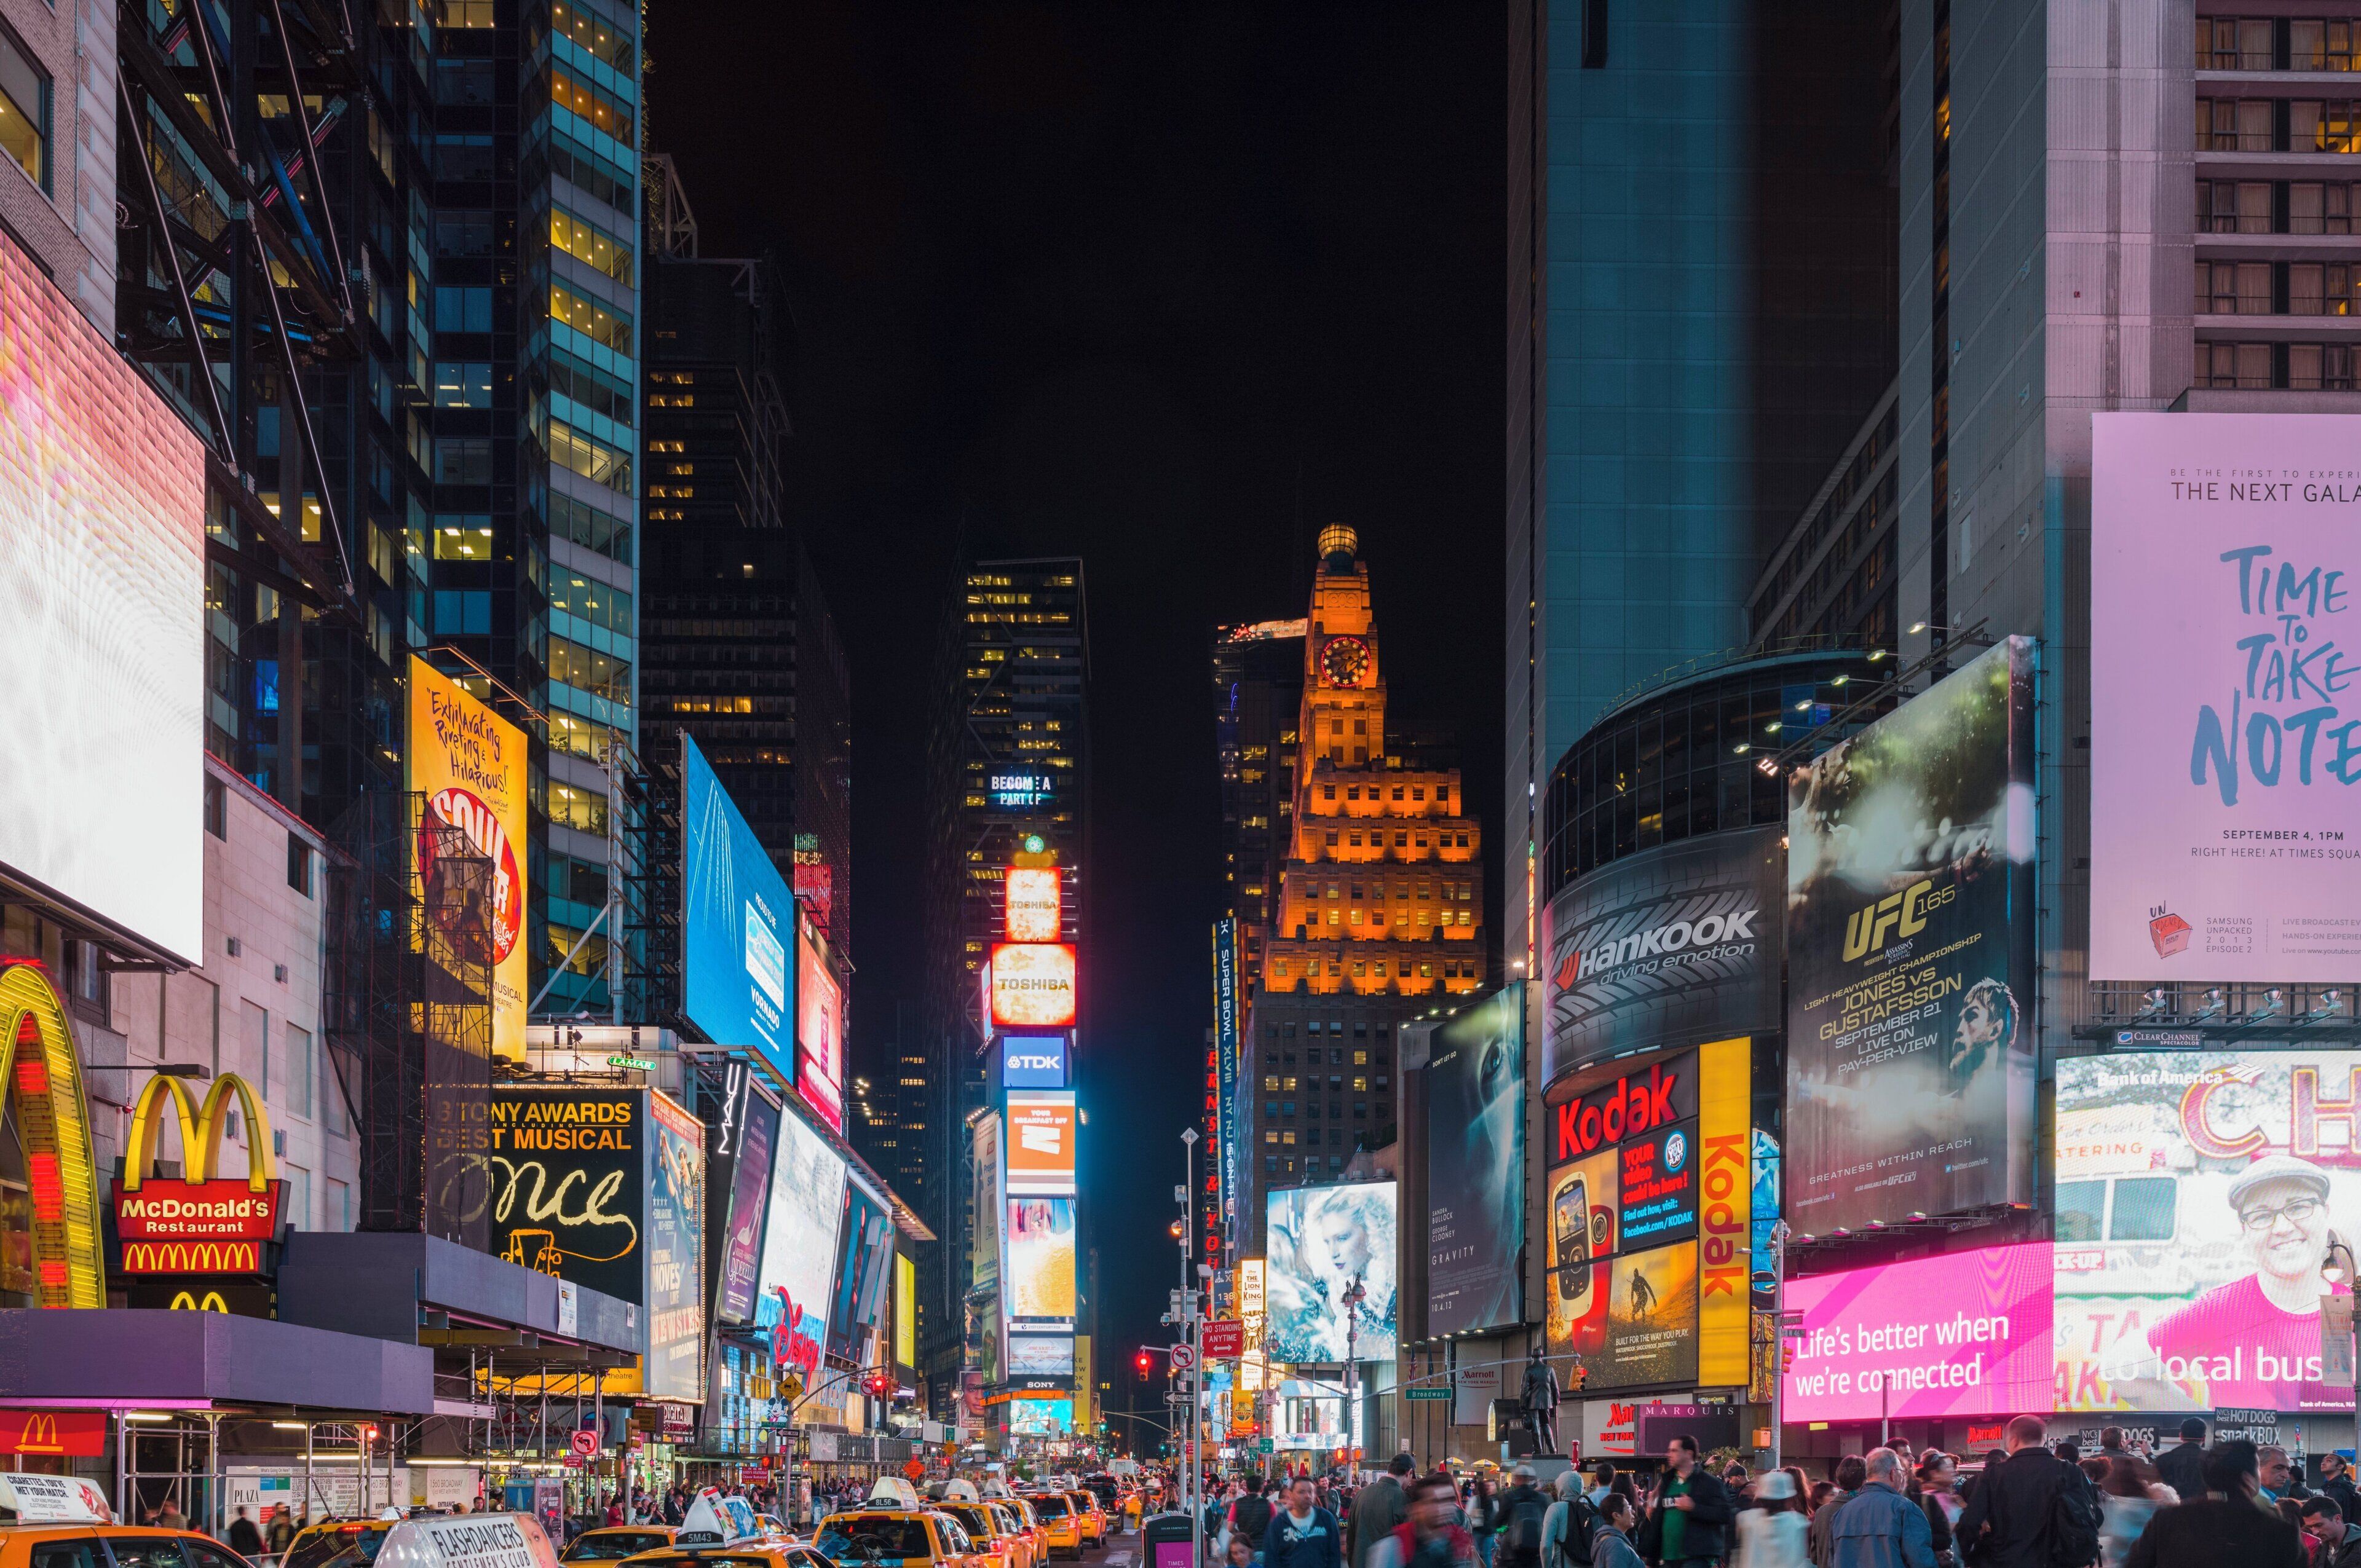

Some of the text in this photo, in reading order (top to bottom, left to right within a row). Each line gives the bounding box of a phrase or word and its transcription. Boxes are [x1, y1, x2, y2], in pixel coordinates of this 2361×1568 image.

[2196, 468, 2222, 477] THE
[2232, 469, 2273, 478] FIRST
[2283, 470, 2300, 479] TO
[2172, 482, 2220, 502] THE
[2230, 483, 2293, 502] NEXT
[2220, 545, 2348, 618] TIME
[2277, 614, 2308, 647] TO
[2236, 633, 2361, 703] TAKE
[2190, 687, 2361, 808] NOTE
[1042, 776, 1051, 790] A
[1000, 793, 1026, 805] PART
[2223, 830, 2344, 841] SEPTEMBER 4, 1PM
[2191, 848, 2324, 859] RIGHT HERE! AT TIMES
[1010, 900, 1057, 910] TOSHIBA
[1842, 880, 1956, 963] UFC 165
[2301, 918, 2349, 927] BROADCAST
[1600, 943, 1755, 986] driving emotion
[1804, 932, 1982, 1011] LIGHT HEAVYWEIGHT CHAMPIONSHIP
[998, 978, 1070, 991] TOSHIBA
[1840, 972, 1907, 1015] JONES
[751, 984, 780, 1030] VORNADO
[1221, 948, 1233, 1084] SUPER BOWL XLVIII
[1819, 972, 1963, 1042] GUSTAFSSON
[1835, 1001, 1942, 1049] SEPTEMBER 21
[1857, 1025, 1915, 1055] LIVE ON
[1019, 1055, 1061, 1070] TDK
[1432, 1053, 1452, 1068] DON'T LET
[1837, 1032, 1939, 1076] PAY-PER-VIEW
[612, 1057, 652, 1070] LAMAR
[2097, 1069, 2223, 1087] Bank of America
[461, 1102, 632, 1124] TONY AWARDS
[1558, 1063, 1679, 1160] Kodak
[437, 1128, 632, 1150] BEST MUSICAL
[1623, 1143, 1655, 1168] YOUR
[1809, 1137, 1973, 1186] GREATNESS WITHIN REACH
[1952, 1156, 1990, 1172] twitter.com/ufc
[1623, 1164, 1653, 1186] video
[1864, 1181, 1882, 1191] AVAILABLE
[121, 1199, 269, 1218] McDonald's
[1795, 1194, 1830, 1208] facebook.com/ufc
[1432, 1207, 1447, 1217] SANDRA
[1432, 1211, 1453, 1225] BULLOCK
[1624, 1199, 1679, 1222] Find out visit:
[1703, 1132, 1745, 1299] Kodak
[146, 1221, 243, 1233] Restaurant
[1432, 1224, 1448, 1235] GEORGE
[1624, 1210, 1693, 1239] Facebook.com/KODAK
[1432, 1229, 1455, 1243] CLOONEY
[1432, 1245, 1474, 1266] GRAVITY
[651, 1262, 681, 1294] MOVES
[1243, 1291, 1262, 1301] KING
[1431, 1301, 1452, 1313] 10.4.13
[651, 1306, 701, 1346] NEWSIES
[1214, 1323, 1241, 1333] STANDING
[1784, 1316, 1803, 1325] BROADWAY
[1209, 1334, 1237, 1343] ANYTIME
[1615, 1328, 1689, 1347] BUILT FOR THE WAY YOU PLAY.
[1797, 1325, 1851, 1360] Life's
[1857, 1322, 1928, 1353] better
[1934, 1310, 2009, 1346] when
[2098, 1346, 2242, 1382] to local
[1461, 1370, 1495, 1380] Marriott
[1795, 1352, 1982, 1397] we're connected
[1645, 1406, 1734, 1416] MARQUIS
[2230, 1410, 2250, 1423] HOT
[2250, 1411, 2276, 1424] DOGS
[1600, 1432, 1635, 1441] NEW YORK
[1968, 1425, 2003, 1444] Marriott
[2081, 1430, 2098, 1438] NYC's
[2082, 1438, 2098, 1446] best
[2124, 1427, 2154, 1444] DOGS
[15, 1486, 69, 1499] MET YOUR MATCH.
[234, 1489, 259, 1503] PLAZA
[875, 1498, 892, 1507] 8L56
[431, 1522, 524, 1558] FLASHDANCERS
[688, 1533, 712, 1543] 5M43
[508, 1550, 531, 1568] CLUB
